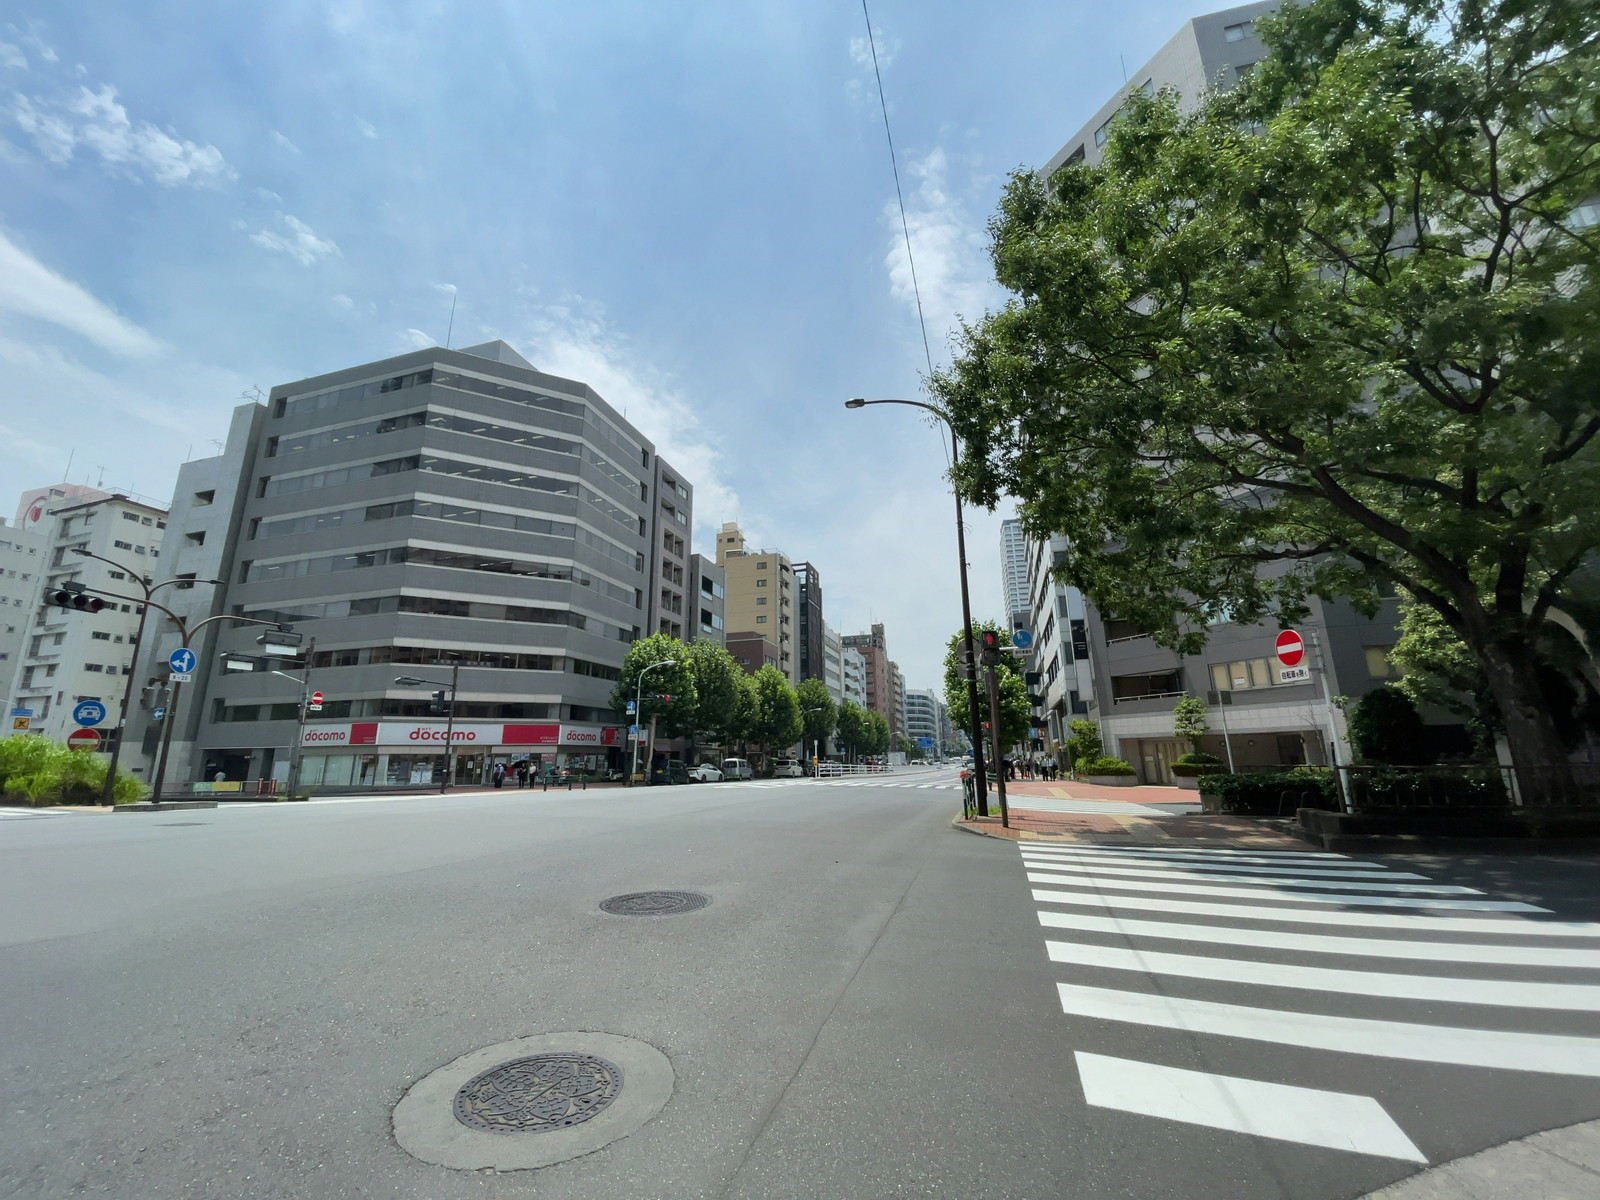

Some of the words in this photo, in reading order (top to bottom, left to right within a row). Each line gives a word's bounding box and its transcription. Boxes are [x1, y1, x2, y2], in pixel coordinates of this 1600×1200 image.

[304, 729, 346, 741] docomo
[409, 727, 476, 741] docomo
[566, 730, 597, 742] docomo
